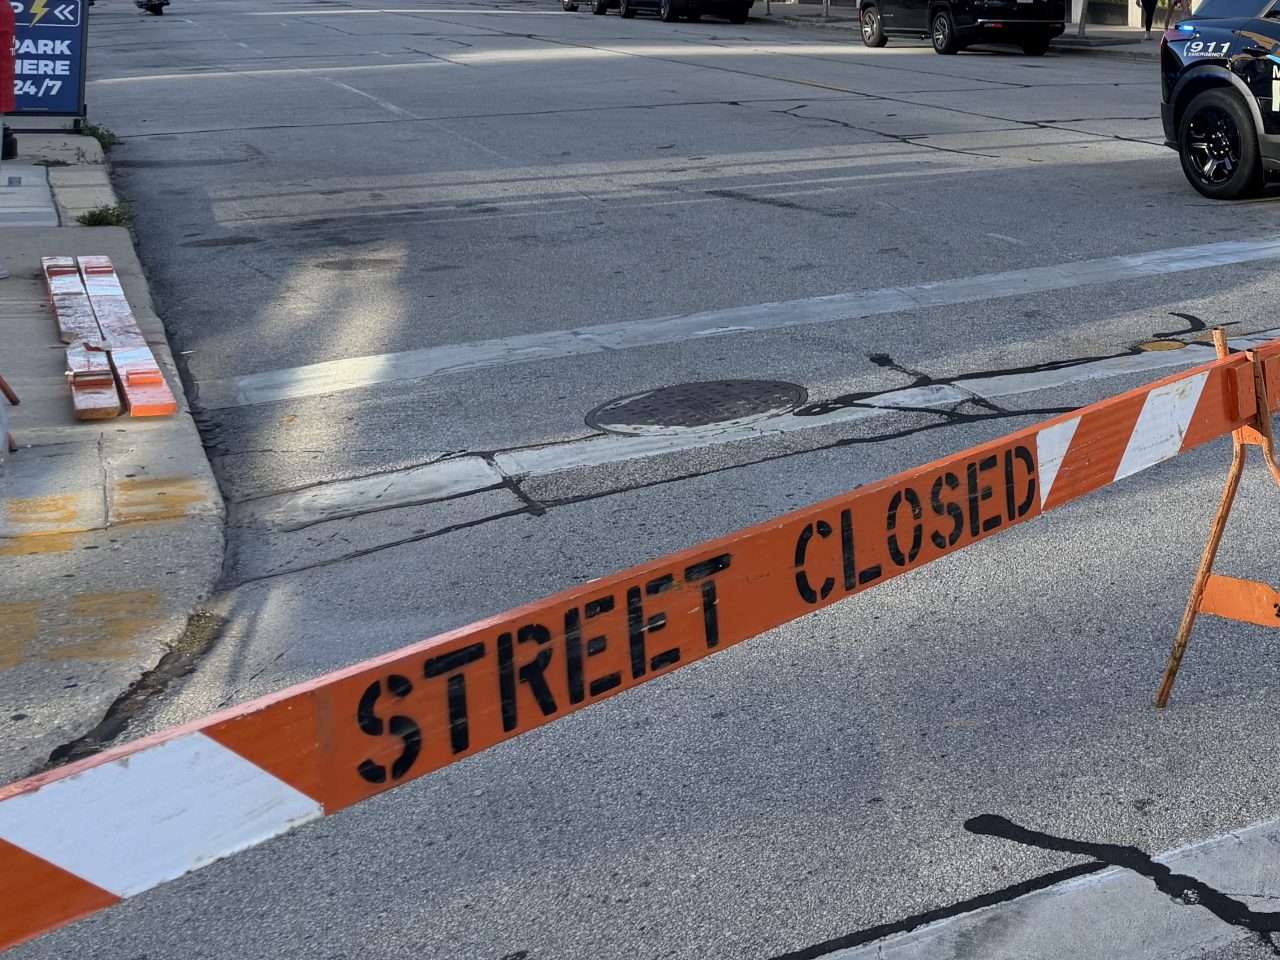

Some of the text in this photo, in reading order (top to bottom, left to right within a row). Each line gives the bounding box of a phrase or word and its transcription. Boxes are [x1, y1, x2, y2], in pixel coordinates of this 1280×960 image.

[1190, 41, 1231, 53] 911
[13, 79, 62, 97] 24/7
[356, 445, 1037, 784] STREET CLOSED
